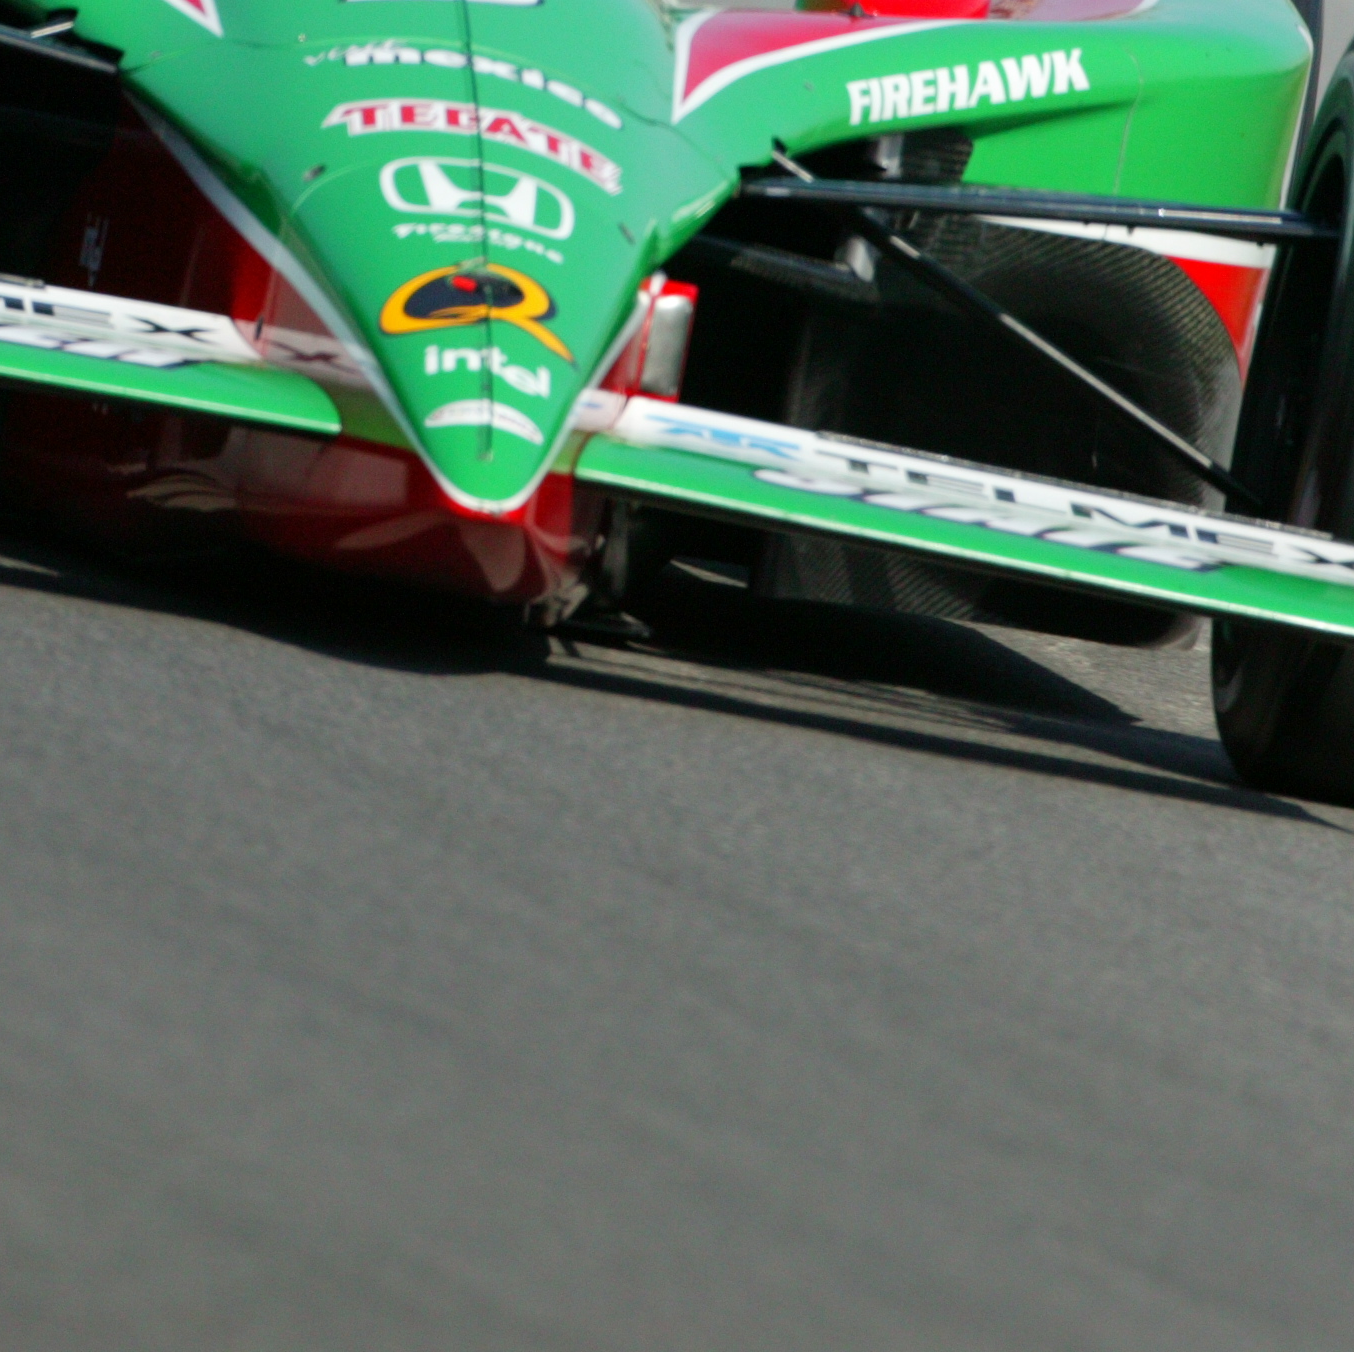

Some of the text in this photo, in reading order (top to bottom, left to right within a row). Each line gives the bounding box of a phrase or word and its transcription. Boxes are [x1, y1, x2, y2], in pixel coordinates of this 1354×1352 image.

[846, 48, 1090, 127] FIREHAWK
[321, 98, 622, 195] TECATE
[425, 344, 551, 399] intel
